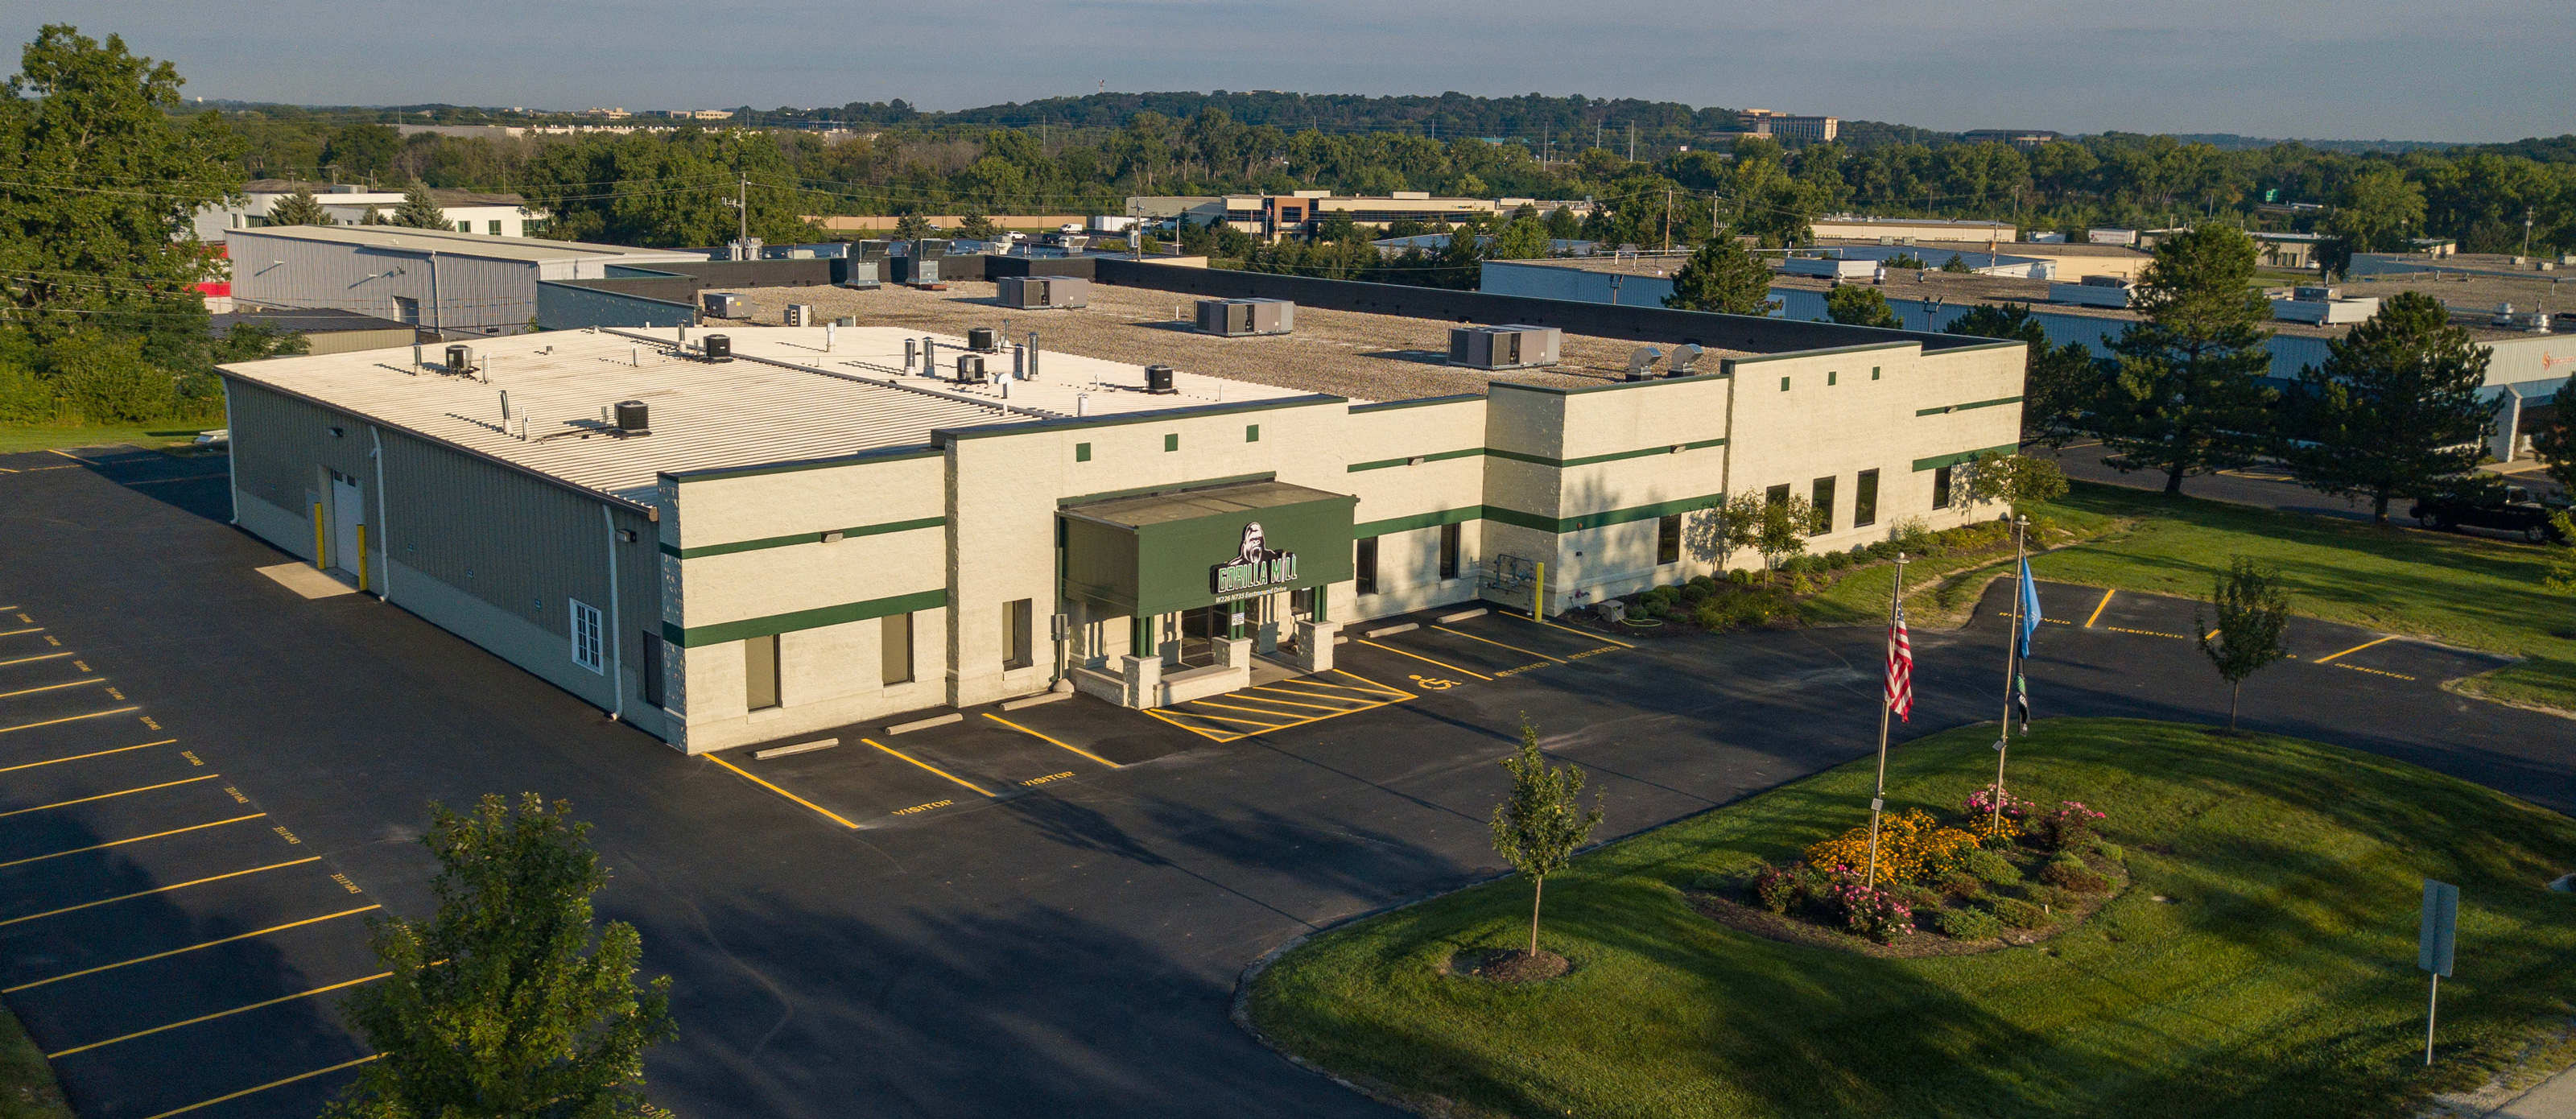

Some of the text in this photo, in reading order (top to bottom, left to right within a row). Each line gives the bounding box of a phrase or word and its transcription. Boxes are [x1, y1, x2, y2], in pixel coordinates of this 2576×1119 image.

[1218, 551, 1298, 593] GORILLA MILL
[1216, 586, 1287, 604] W226 N735 Eastmound Drive
[2107, 626, 2184, 639] RESERVED
[1494, 662, 1550, 677] RESERVED
[1019, 770, 1075, 787] VISITOR
[892, 799, 954, 816] VISITOR
